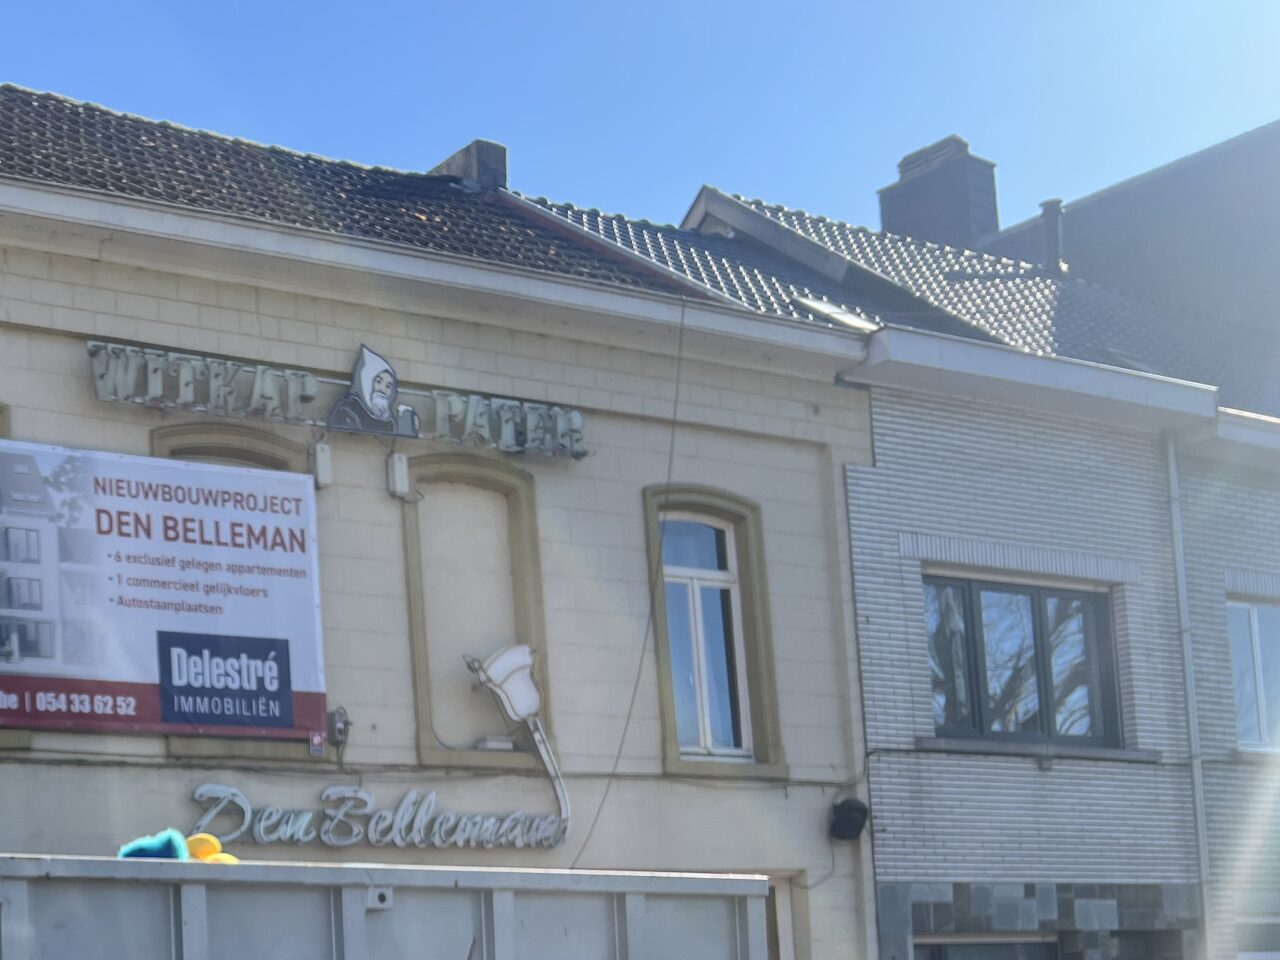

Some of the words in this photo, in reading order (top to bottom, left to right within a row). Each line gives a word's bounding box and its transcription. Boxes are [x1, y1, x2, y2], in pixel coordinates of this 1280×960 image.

[87, 340, 319, 421] WITKAP
[431, 389, 588, 458] PATER
[93, 476, 303, 516] NIEUWBOUWPROJECT
[95, 508, 152, 540] DEN
[162, 515, 307, 554] BELLEMAN
[114, 551, 122, 562] 6
[125, 553, 177, 567] exclusief
[179, 558, 222, 573] gelegen
[225, 563, 307, 579] appartementen
[117, 575, 123, 585] 1
[126, 576, 200, 592] commercieel
[202, 582, 270, 598] gelijkvloers
[116, 596, 224, 615] Autostaanplaatsen
[170, 647, 280, 692] Delestré
[35, 692, 67, 712] 054
[70, 695, 90, 713] 33
[93, 695, 114, 714] 62
[116, 696, 136, 716] 52
[173, 695, 282, 717] IMMOBILIËN
[192, 783, 316, 845] Den
